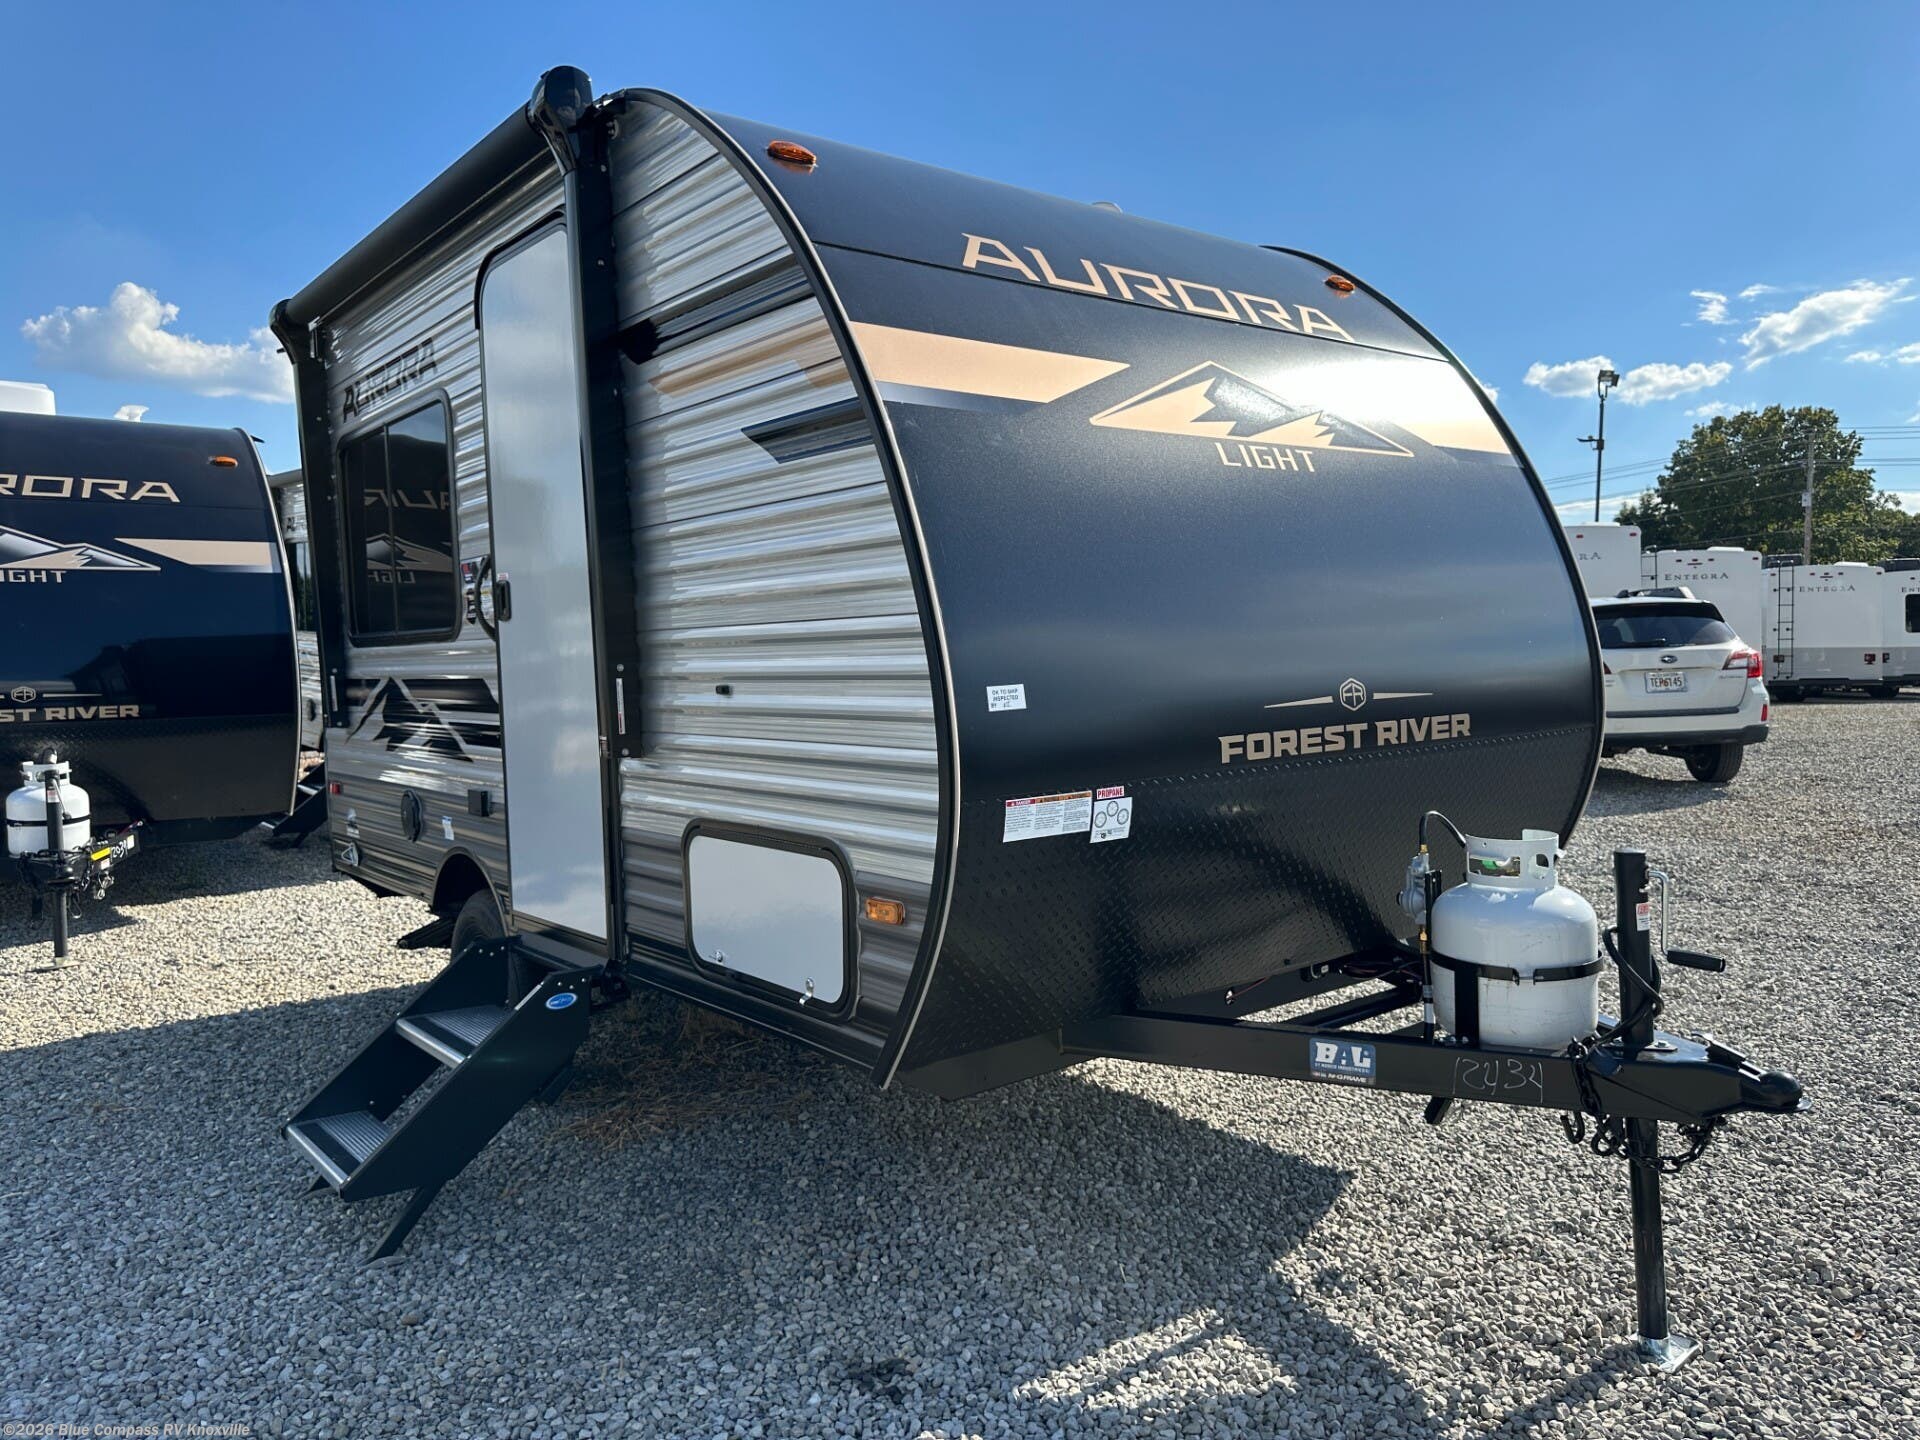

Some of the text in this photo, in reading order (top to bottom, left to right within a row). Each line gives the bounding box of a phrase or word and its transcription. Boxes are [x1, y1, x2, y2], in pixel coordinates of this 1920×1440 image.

[961, 232, 1357, 342] AURORA
[342, 337, 438, 423] AURORA
[1215, 442, 1315, 473] LIGHT
[1664, 572, 1729, 581] ENTEGRA
[44, 705, 139, 720] RIVER
[1218, 713, 1471, 764] FOREST RIVER
[1097, 786, 1123, 799] PROPANE
